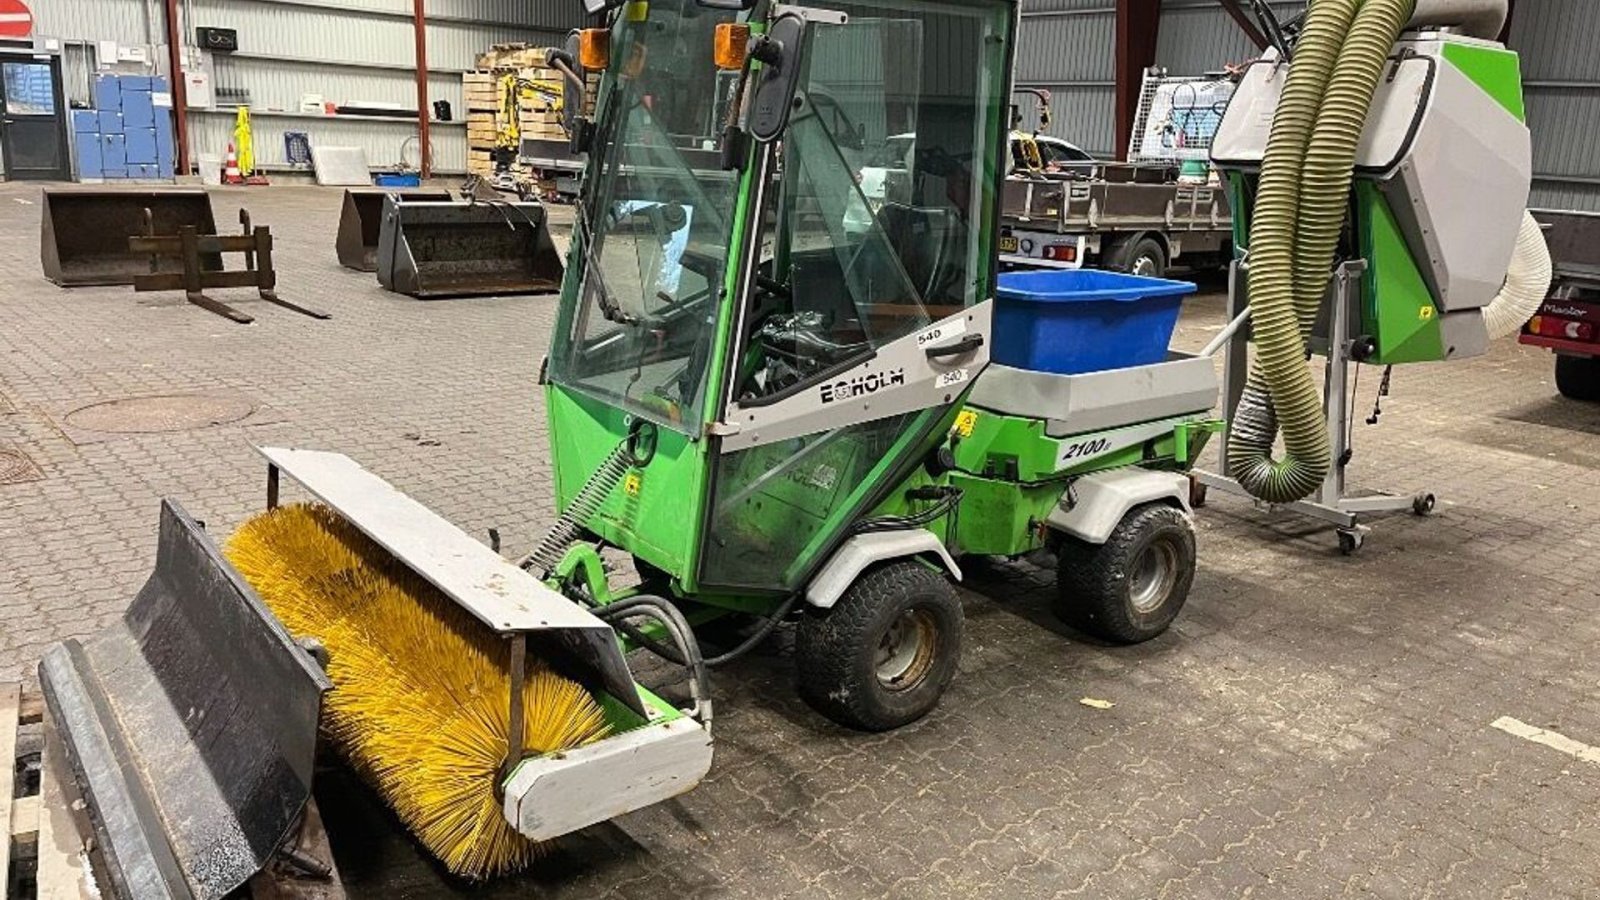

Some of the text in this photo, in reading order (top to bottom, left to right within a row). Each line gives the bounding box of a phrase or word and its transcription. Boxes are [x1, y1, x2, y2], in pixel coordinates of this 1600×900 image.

[1544, 304, 1588, 317] Master
[918, 329, 942, 345] 540
[943, 370, 963, 385] 540
[820, 368, 905, 404] EGHOLM
[1062, 437, 1106, 460] 2100
